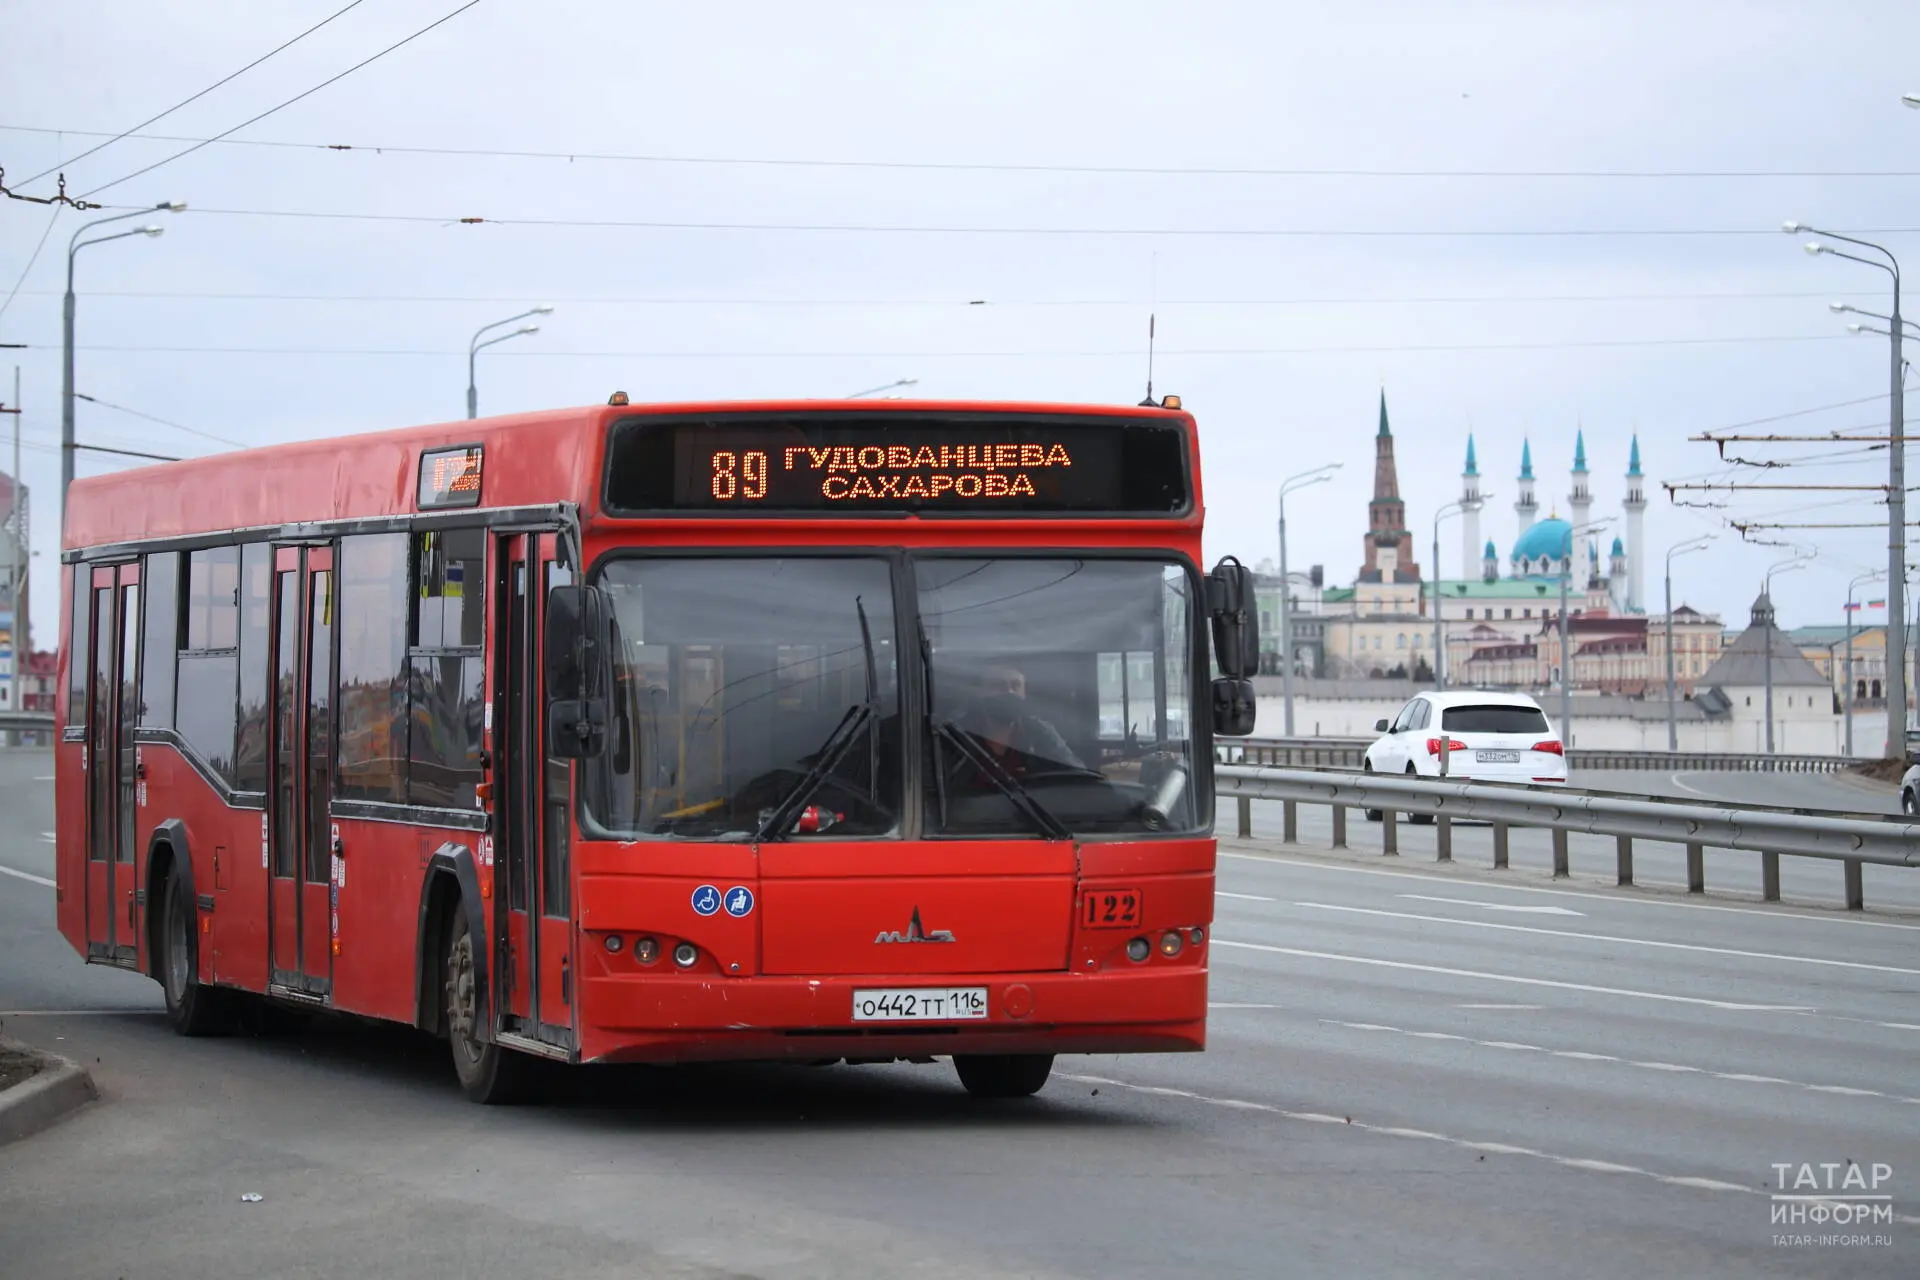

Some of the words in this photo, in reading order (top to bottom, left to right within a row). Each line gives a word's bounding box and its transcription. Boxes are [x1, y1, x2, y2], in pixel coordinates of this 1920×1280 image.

[784, 444, 1072, 473] ГУДОВАНЦЕВА
[712, 451, 768, 499] 89
[821, 474, 1036, 500] САХАРОВА
[1088, 895, 1136, 923] 122
[950, 992, 981, 1009] 116
